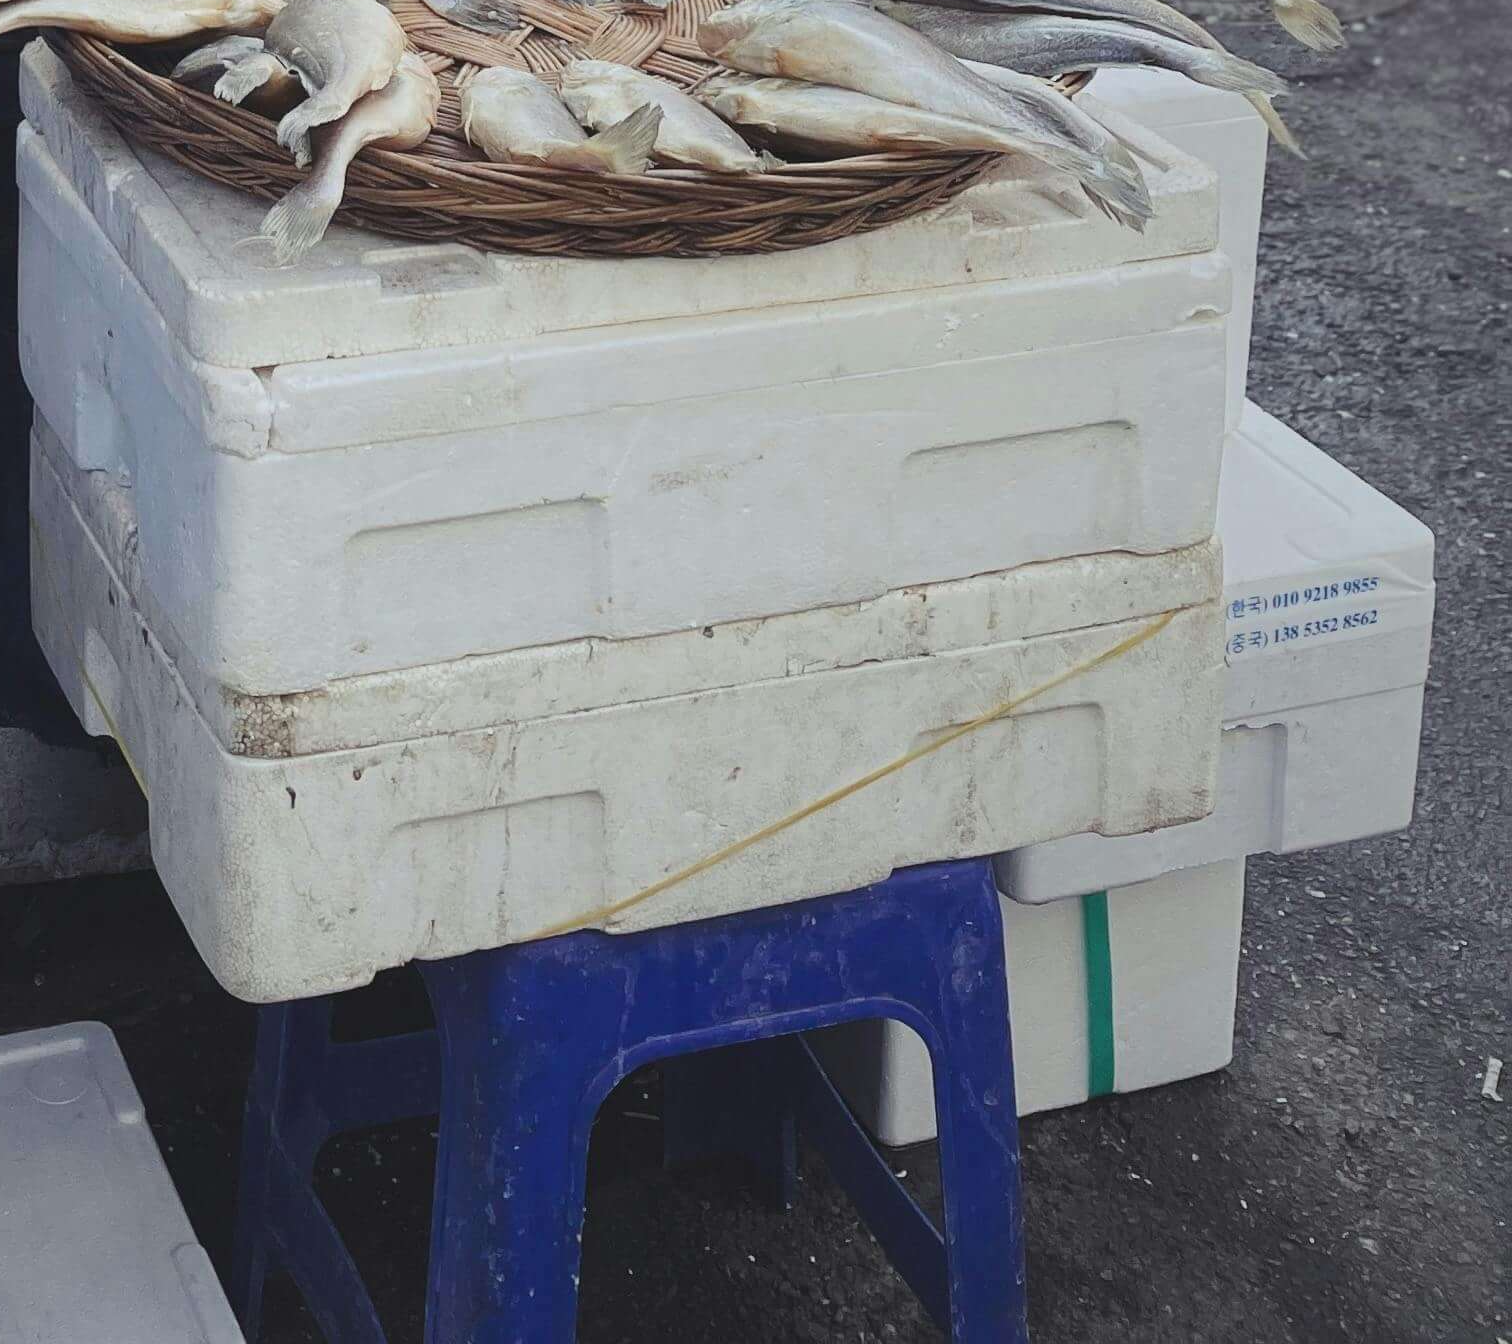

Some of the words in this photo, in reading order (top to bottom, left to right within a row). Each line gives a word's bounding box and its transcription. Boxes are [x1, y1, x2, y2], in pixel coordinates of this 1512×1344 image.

[1273, 591, 1299, 609] 010
[1303, 583, 1338, 602] 9218
[1343, 576, 1380, 595] 9855
[1225, 630, 1268, 654] (중국)
[1274, 625, 1299, 643] 138
[1303, 617, 1338, 637] 5352
[1343, 610, 1378, 630] 8562
